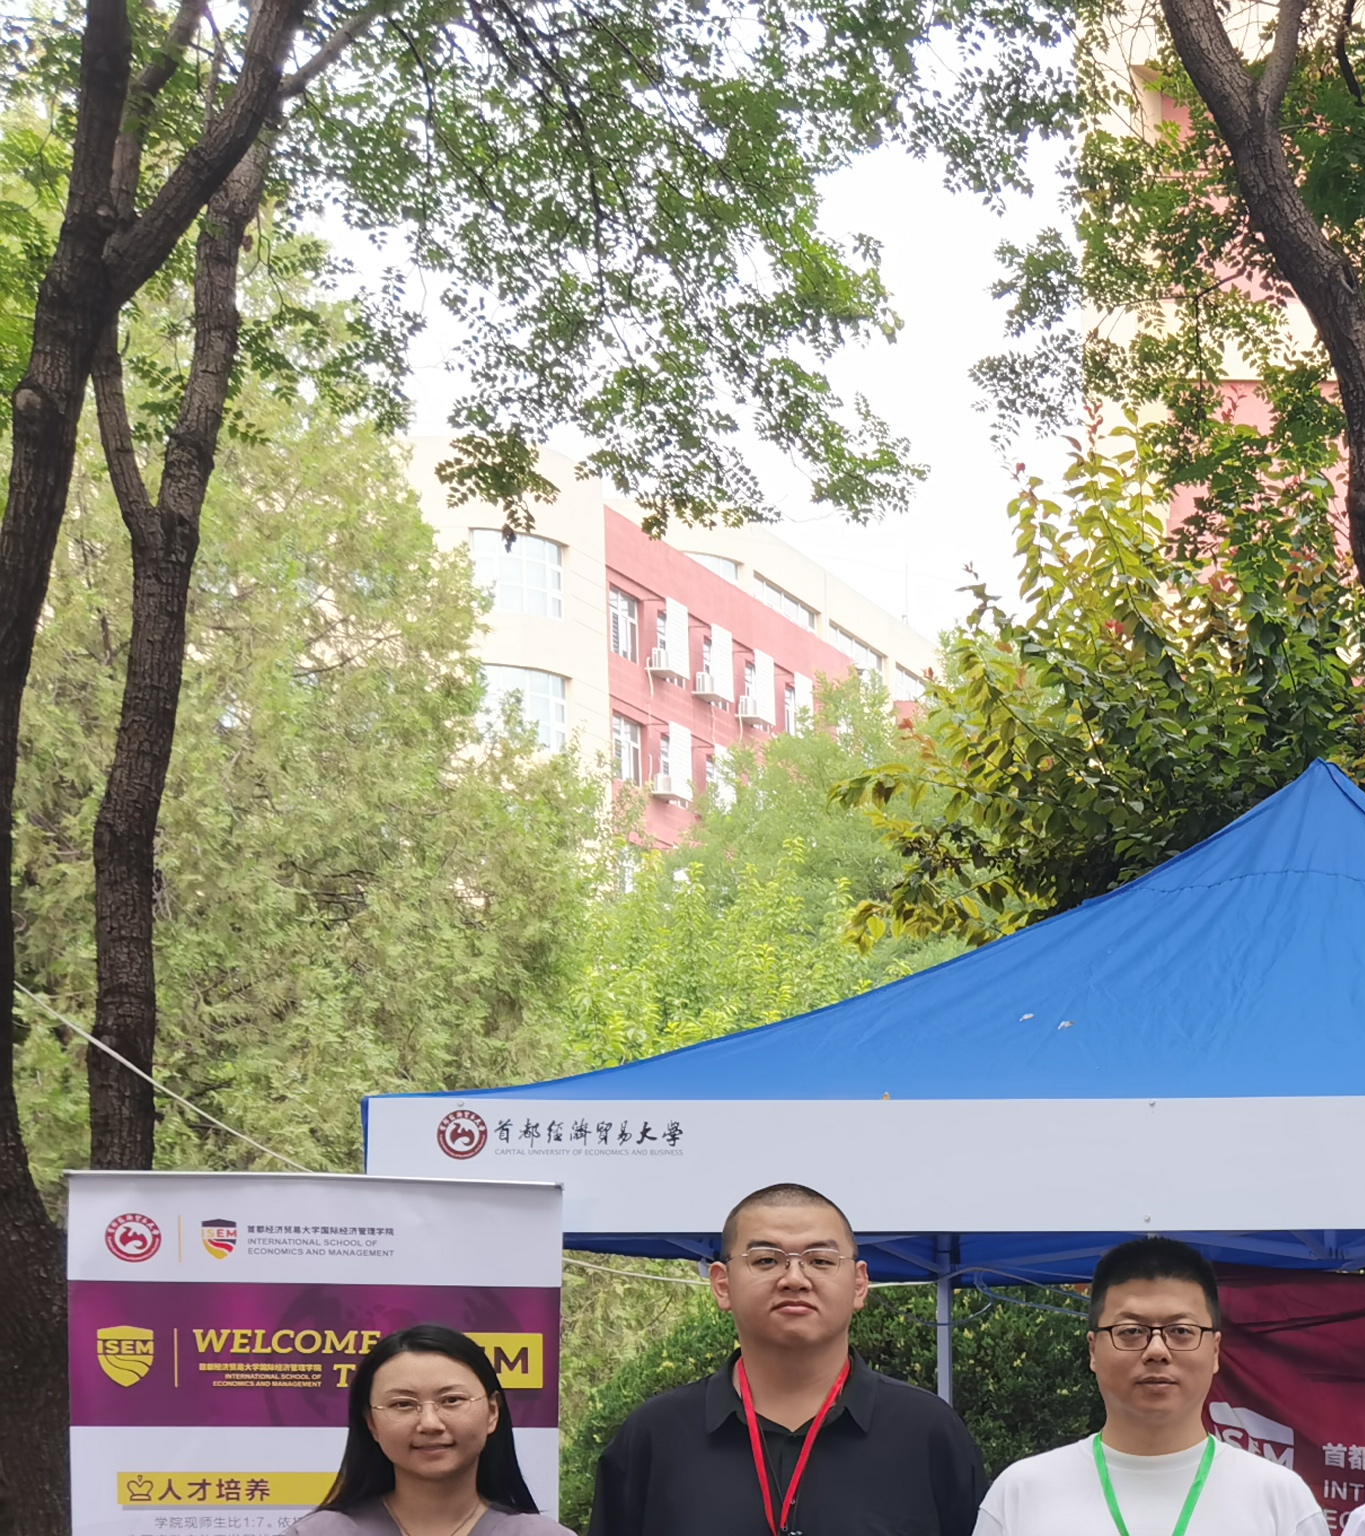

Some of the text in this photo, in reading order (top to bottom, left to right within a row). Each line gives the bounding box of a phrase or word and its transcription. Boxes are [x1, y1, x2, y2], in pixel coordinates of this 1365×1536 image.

[201, 1228, 237, 1238] ISEM
[248, 1238, 377, 1247] INTERNATIONAL SCHOOL OF
[248, 1248, 394, 1257] ECONOMICS AND MANAGEMENT
[97, 1340, 154, 1355] ISEM
[158, 1479, 270, 1501] 人才培养
